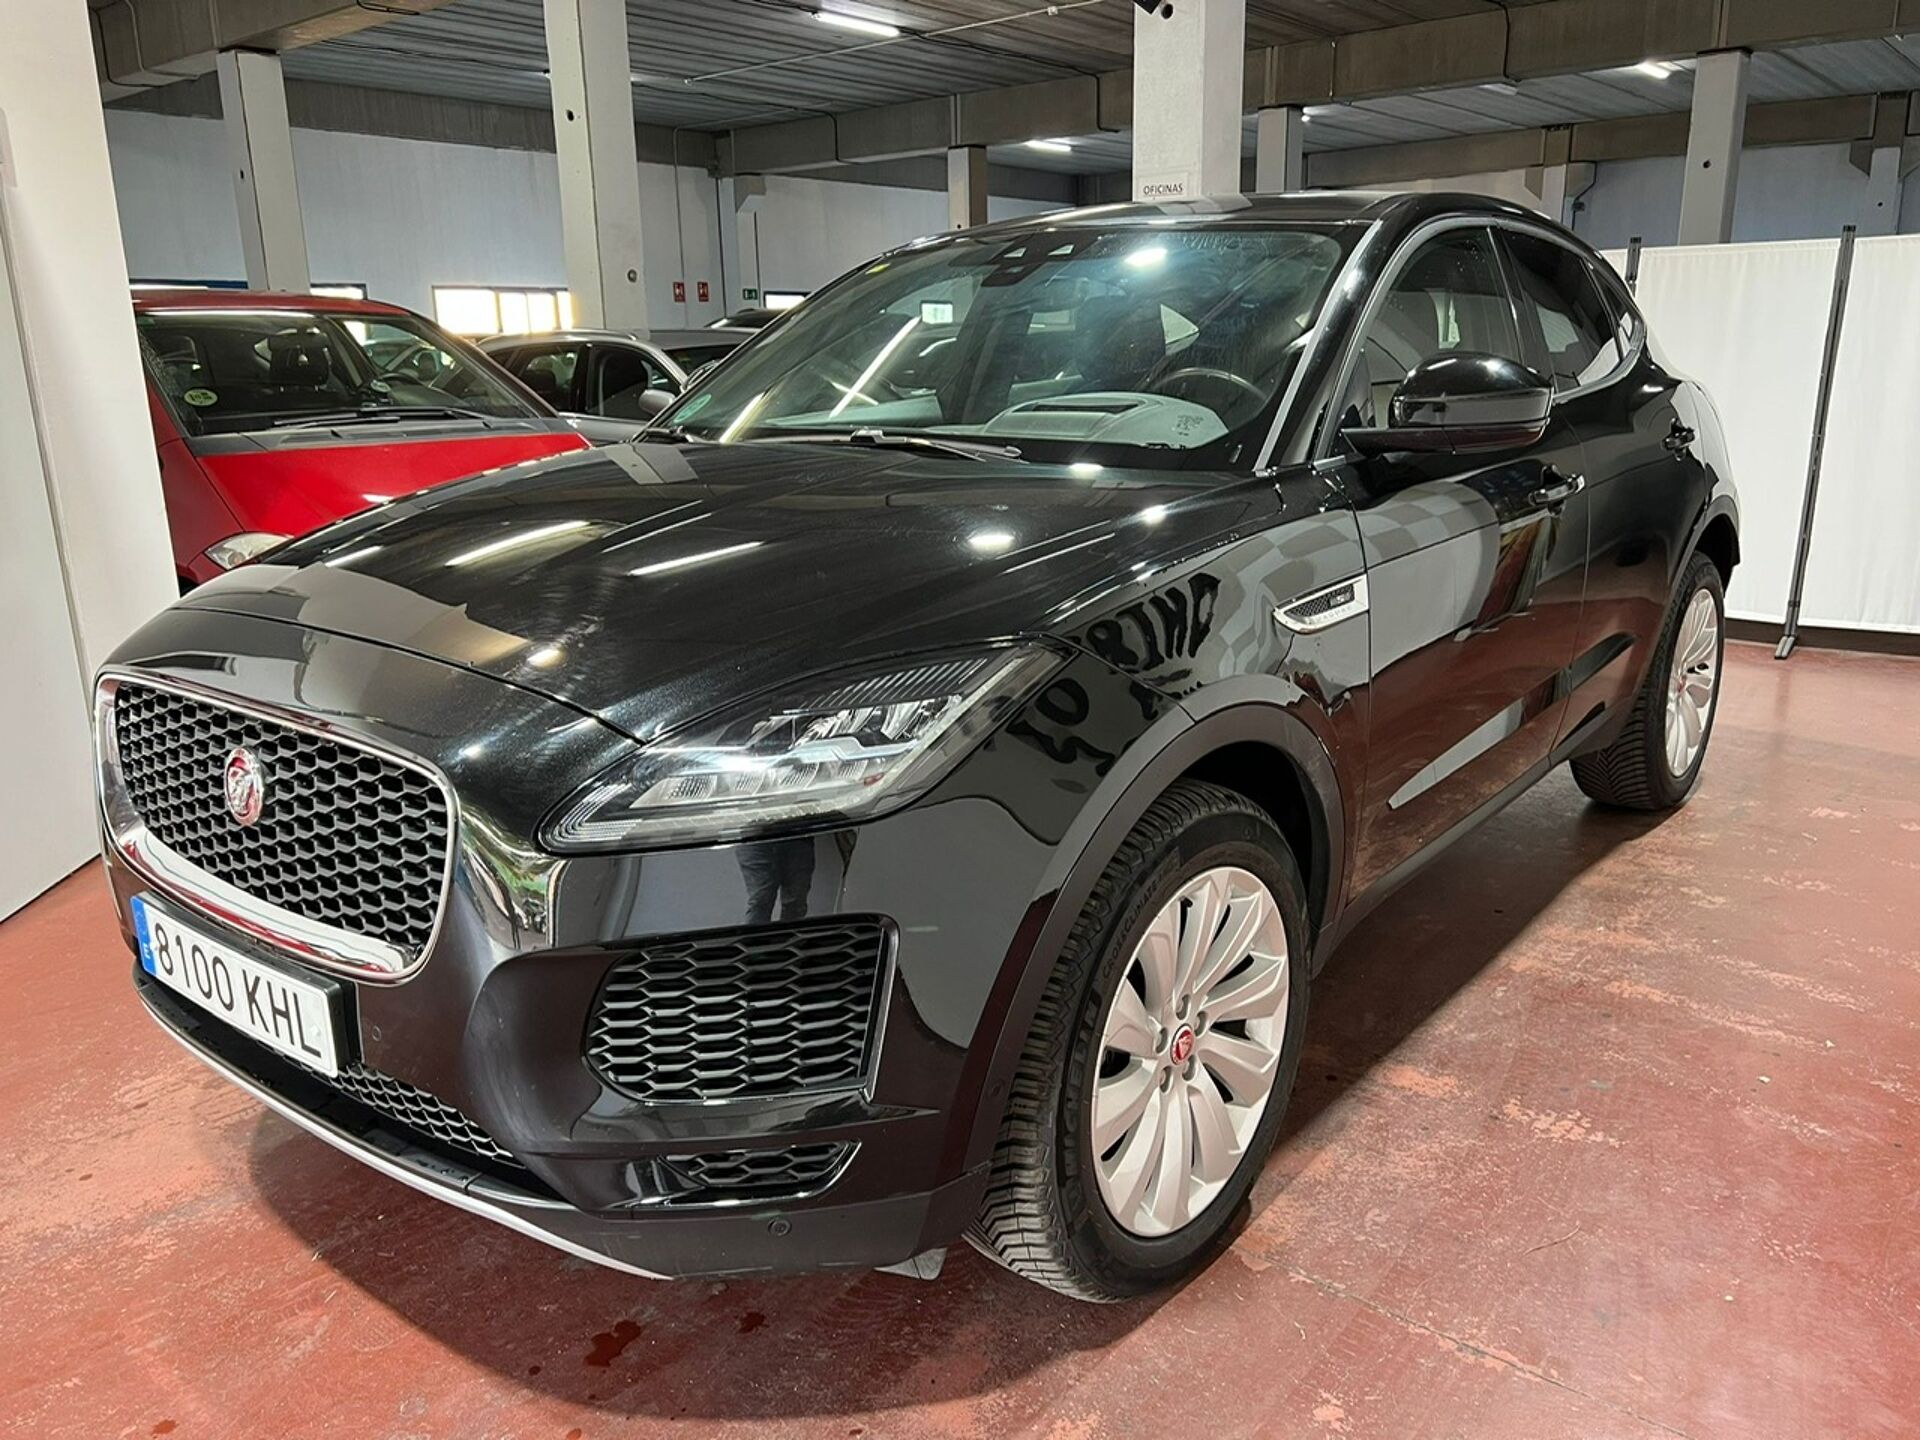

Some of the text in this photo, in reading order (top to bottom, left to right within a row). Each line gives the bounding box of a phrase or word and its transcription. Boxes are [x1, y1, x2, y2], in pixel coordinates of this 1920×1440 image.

[1143, 183, 1183, 195] OFICINAS
[154, 922, 322, 1059] 8100 KHL
[1062, 988, 1103, 1180] MICHELIN
